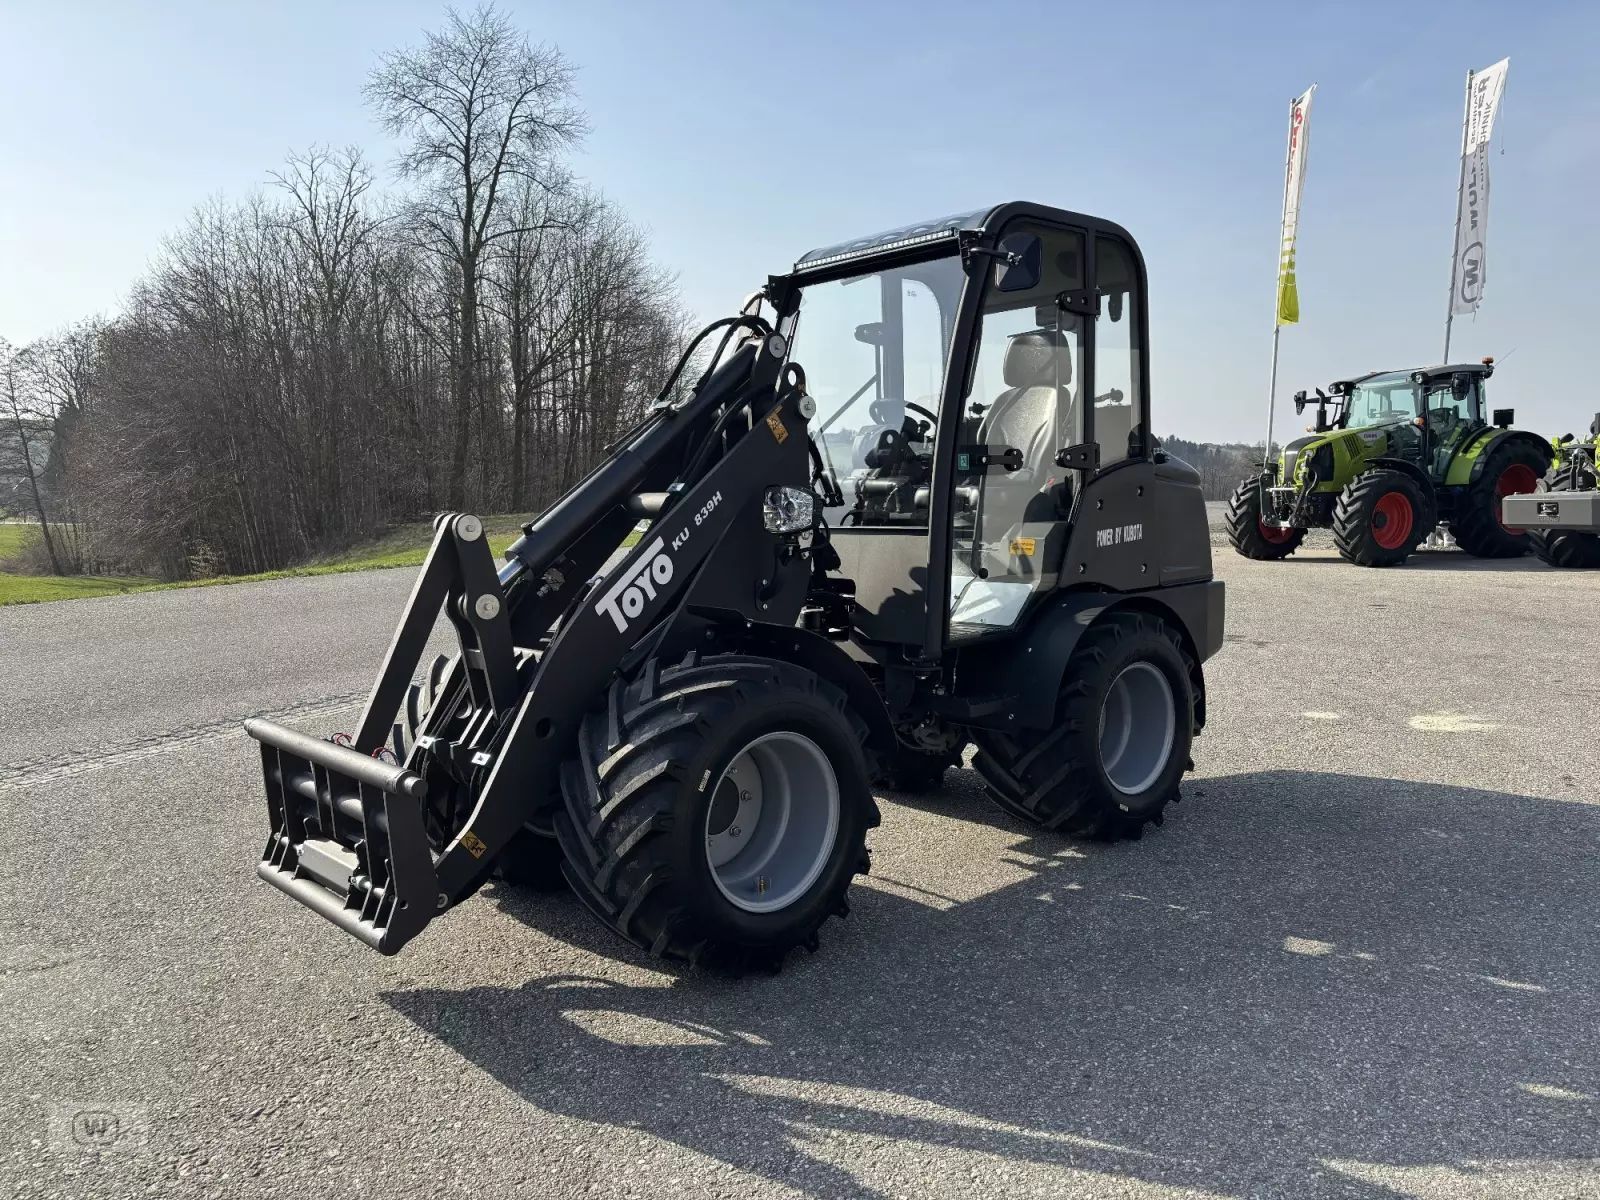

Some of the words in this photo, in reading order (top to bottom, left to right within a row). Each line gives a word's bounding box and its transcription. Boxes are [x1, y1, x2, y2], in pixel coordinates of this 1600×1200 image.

[594, 535, 674, 634] TOYO
[671, 527, 690, 551] KU
[694, 490, 723, 526] 839H
[1096, 528, 1113, 548] POWER
[1115, 526, 1123, 544] BY
[1123, 523, 1142, 543] KUBOTA
